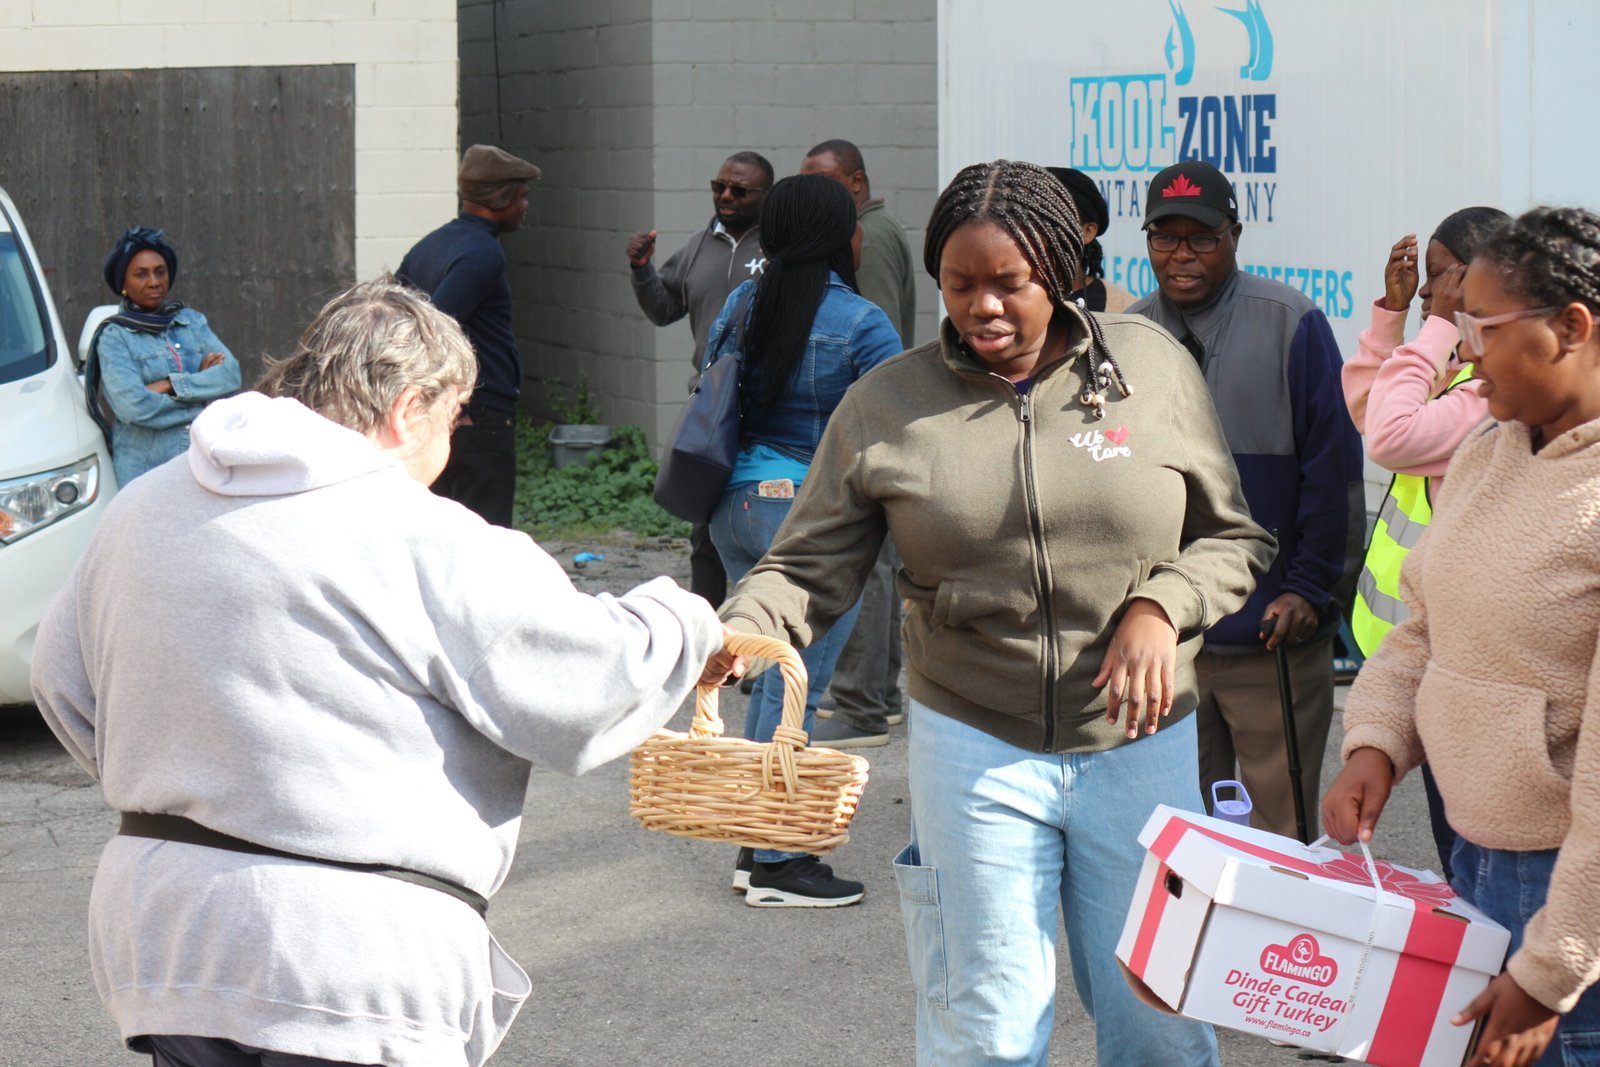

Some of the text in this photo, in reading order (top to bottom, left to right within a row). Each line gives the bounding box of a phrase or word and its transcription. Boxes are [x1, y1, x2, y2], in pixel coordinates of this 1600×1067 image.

[1070, 73, 1277, 173] KOOL ZONE
[1069, 429, 1105, 447] We
[1087, 444, 1131, 461] Care
[1263, 951, 1332, 983] FLAMINGO
[1224, 969, 1281, 996] Dinde
[1232, 991, 1338, 1032] Gift Turkey
[1244, 1015, 1312, 1037] www.flamingo.ca
